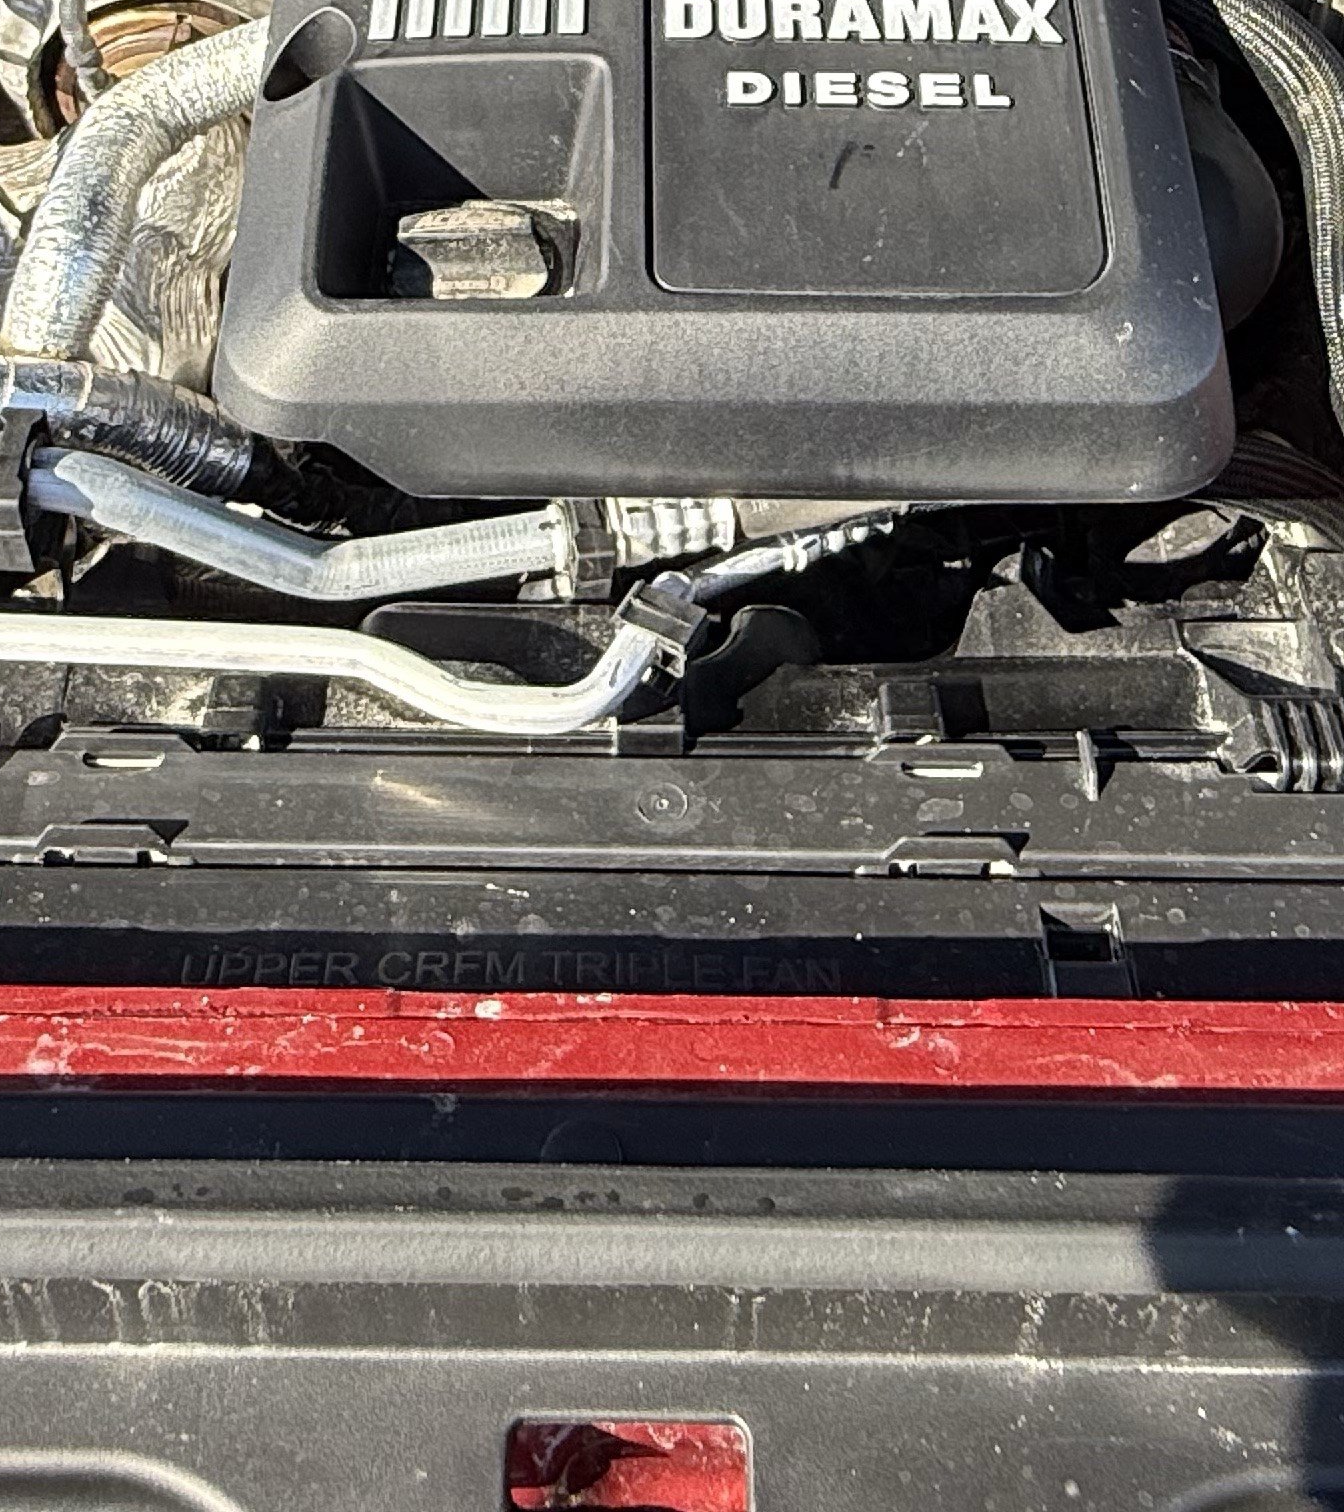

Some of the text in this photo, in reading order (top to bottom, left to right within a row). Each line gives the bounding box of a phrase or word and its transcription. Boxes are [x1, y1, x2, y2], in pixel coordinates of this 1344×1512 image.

[726, 70, 1015, 108] DIESEL
[180, 949, 843, 993] UPPER CRFM TRIPLE FAN
